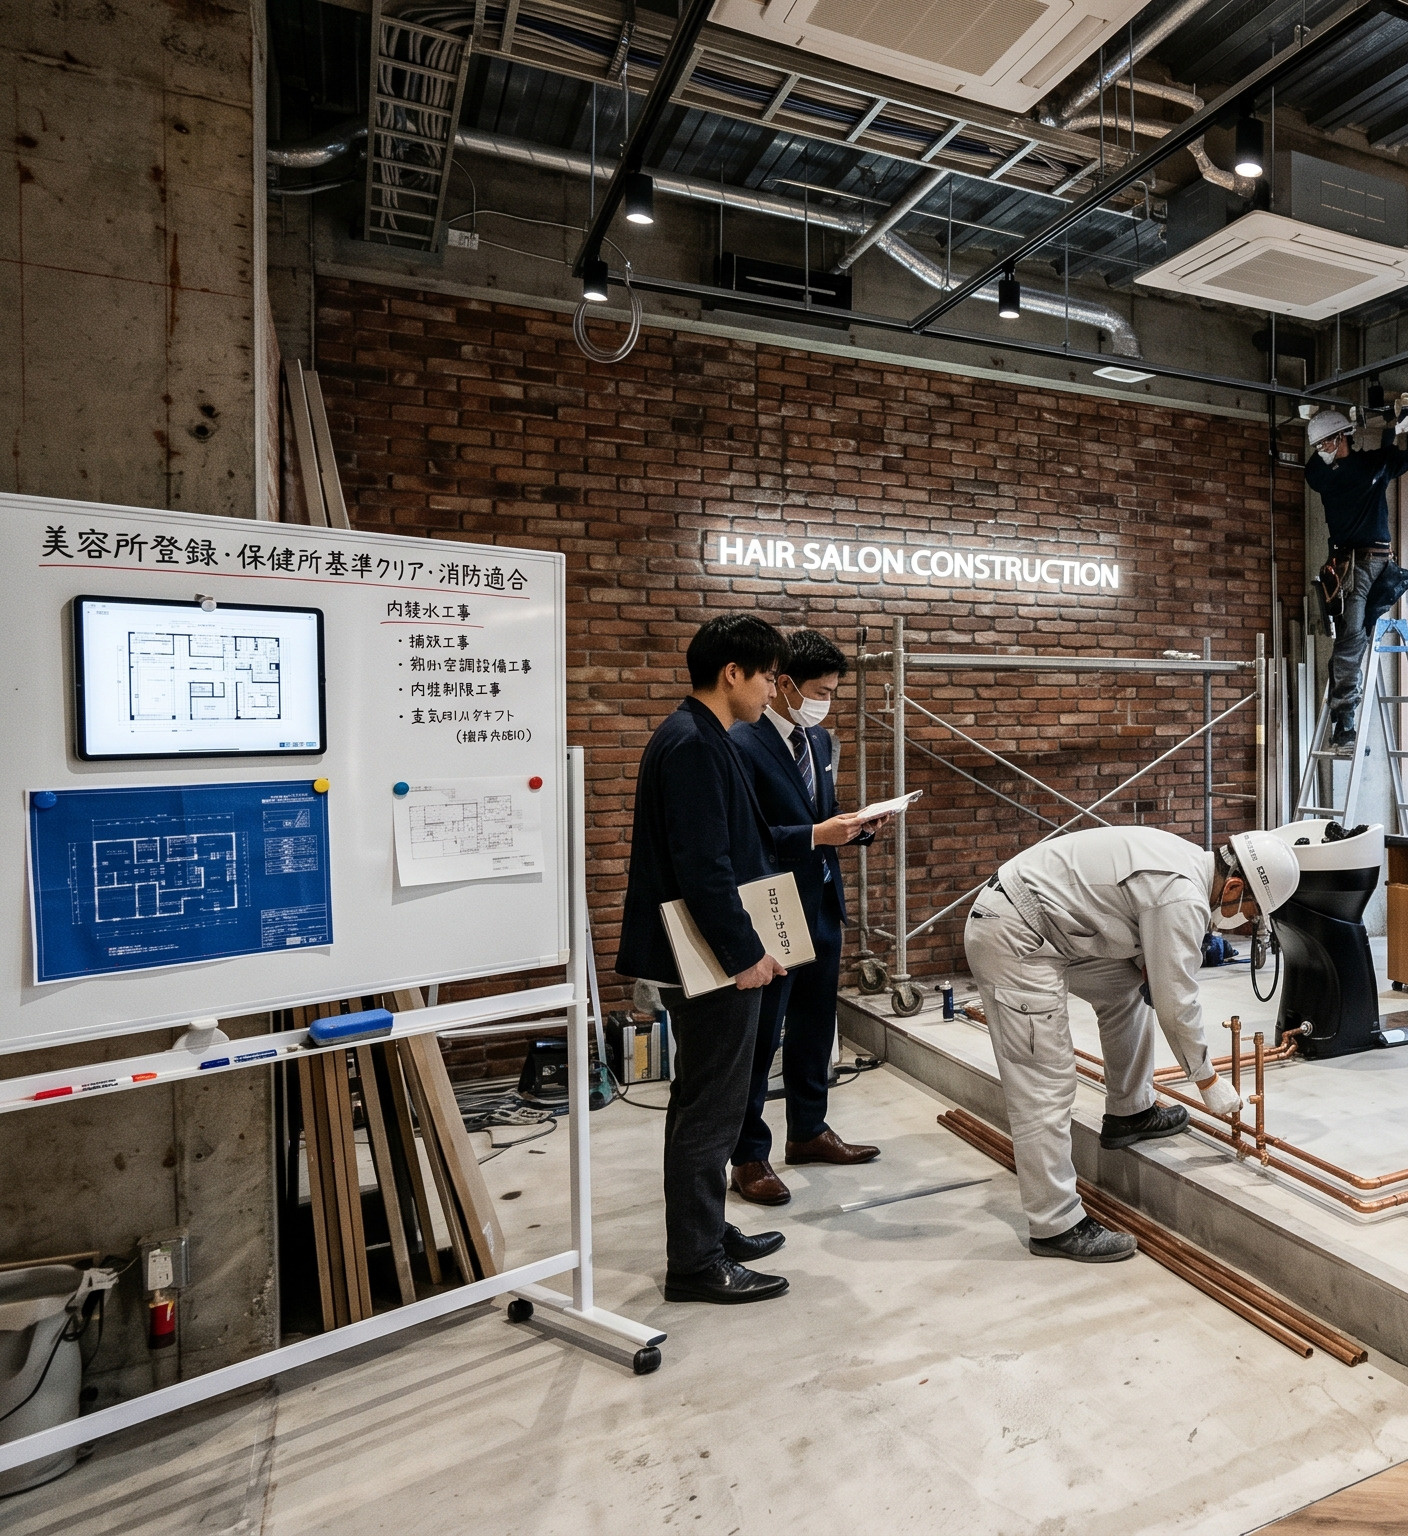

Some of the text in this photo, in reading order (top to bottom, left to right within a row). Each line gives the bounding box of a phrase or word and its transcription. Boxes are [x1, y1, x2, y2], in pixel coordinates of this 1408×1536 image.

[42, 525, 528, 591] 美容所登録・保健所基準クリア・消防適合
[719, 536, 1119, 588] HAIR SALON CONSTRUCTION
